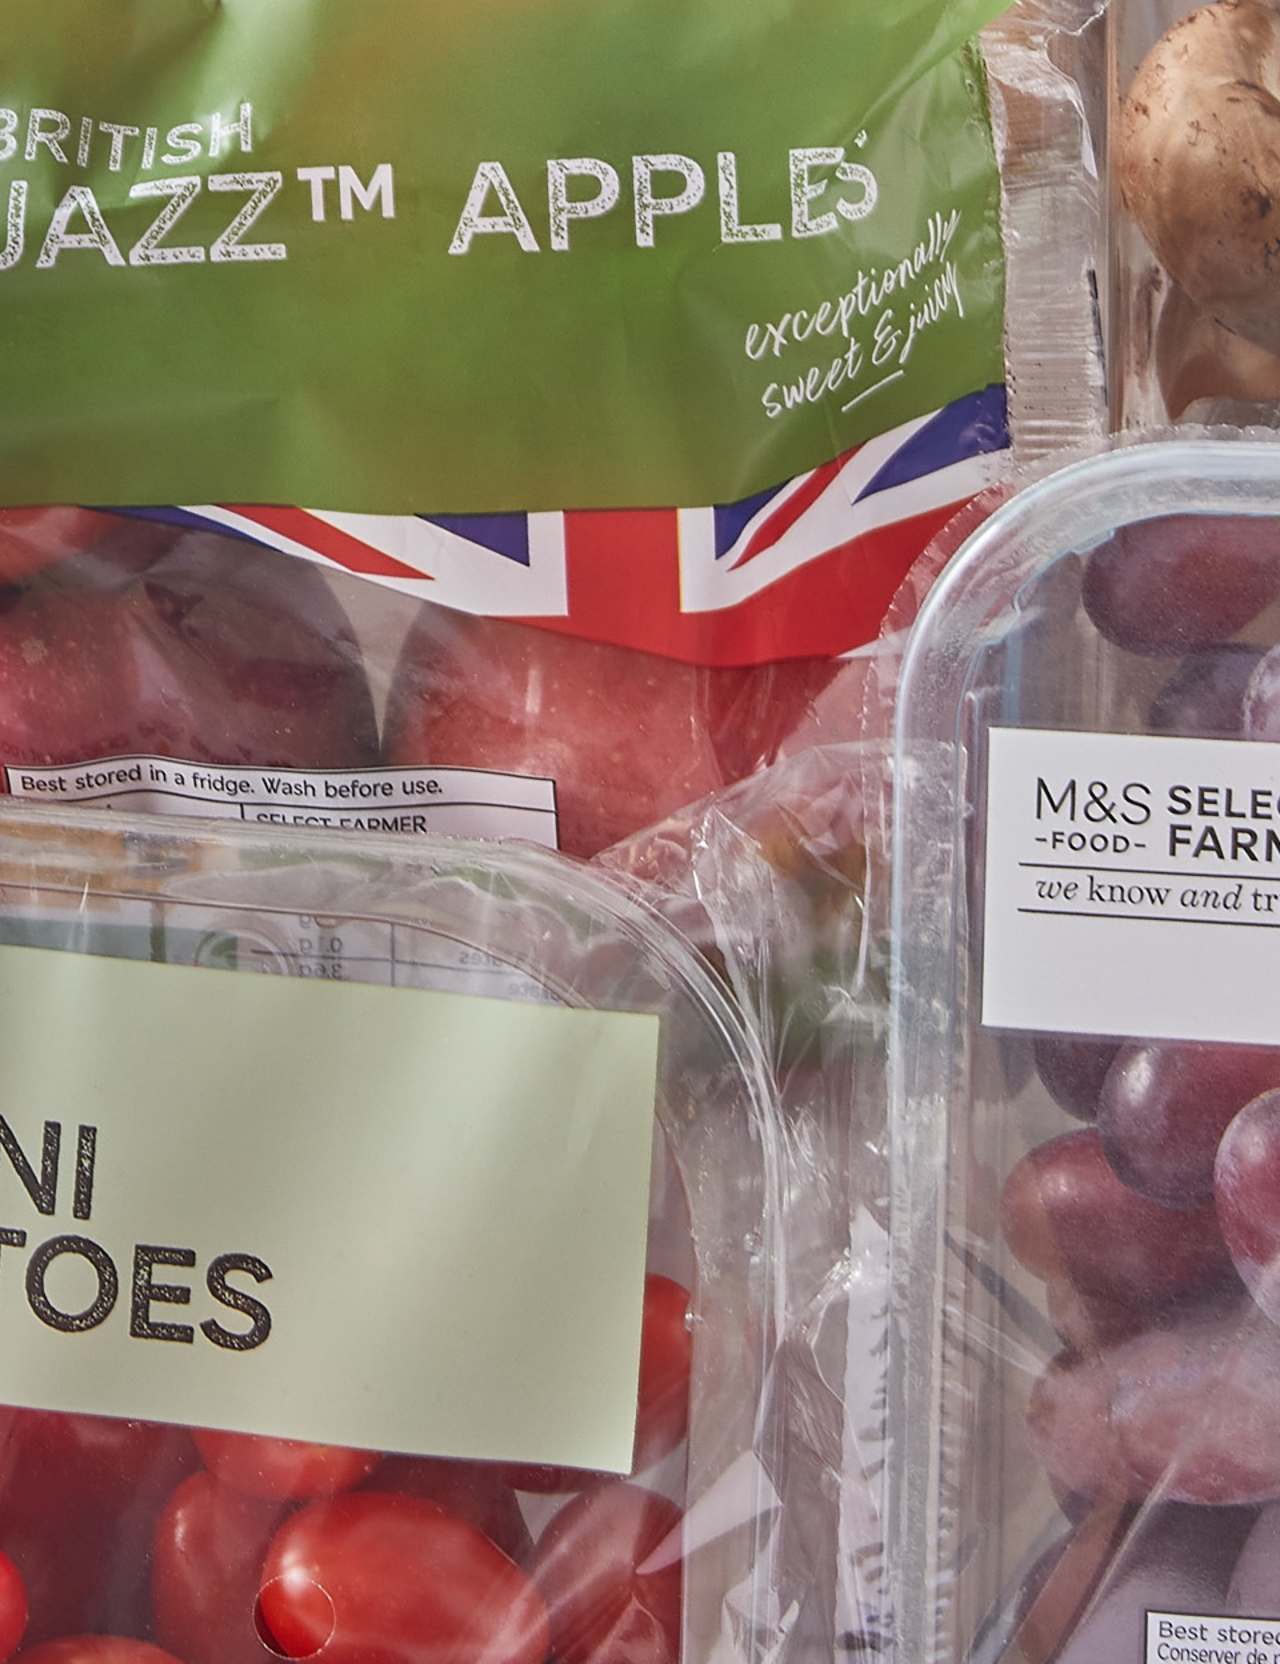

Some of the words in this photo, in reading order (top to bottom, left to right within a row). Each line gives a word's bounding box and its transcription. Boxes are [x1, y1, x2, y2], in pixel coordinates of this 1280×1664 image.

[447, 144, 880, 256] APPLES
[744, 208, 962, 361] exceptionally
[761, 337, 864, 418] sweet
[872, 308, 902, 365] &
[20, 774, 67, 793] Best
[75, 764, 142, 790] stored
[149, 764, 167, 783] in
[174, 773, 185, 786] a
[192, 772, 255, 796] fridge.
[261, 777, 316, 797] Wash
[324, 780, 394, 798] before
[402, 777, 443, 796] use.
[1036, 776, 1151, 825] M&S
[1168, 785, 1280, 820] SELE
[1036, 880, 1078, 900] we
[1087, 875, 1171, 905] know
[1180, 885, 1243, 911] and
[1159, 1621, 1208, 1641] Best
[1157, 1642, 1241, 1664] Conserver
[1247, 1648, 1268, 1664] de
